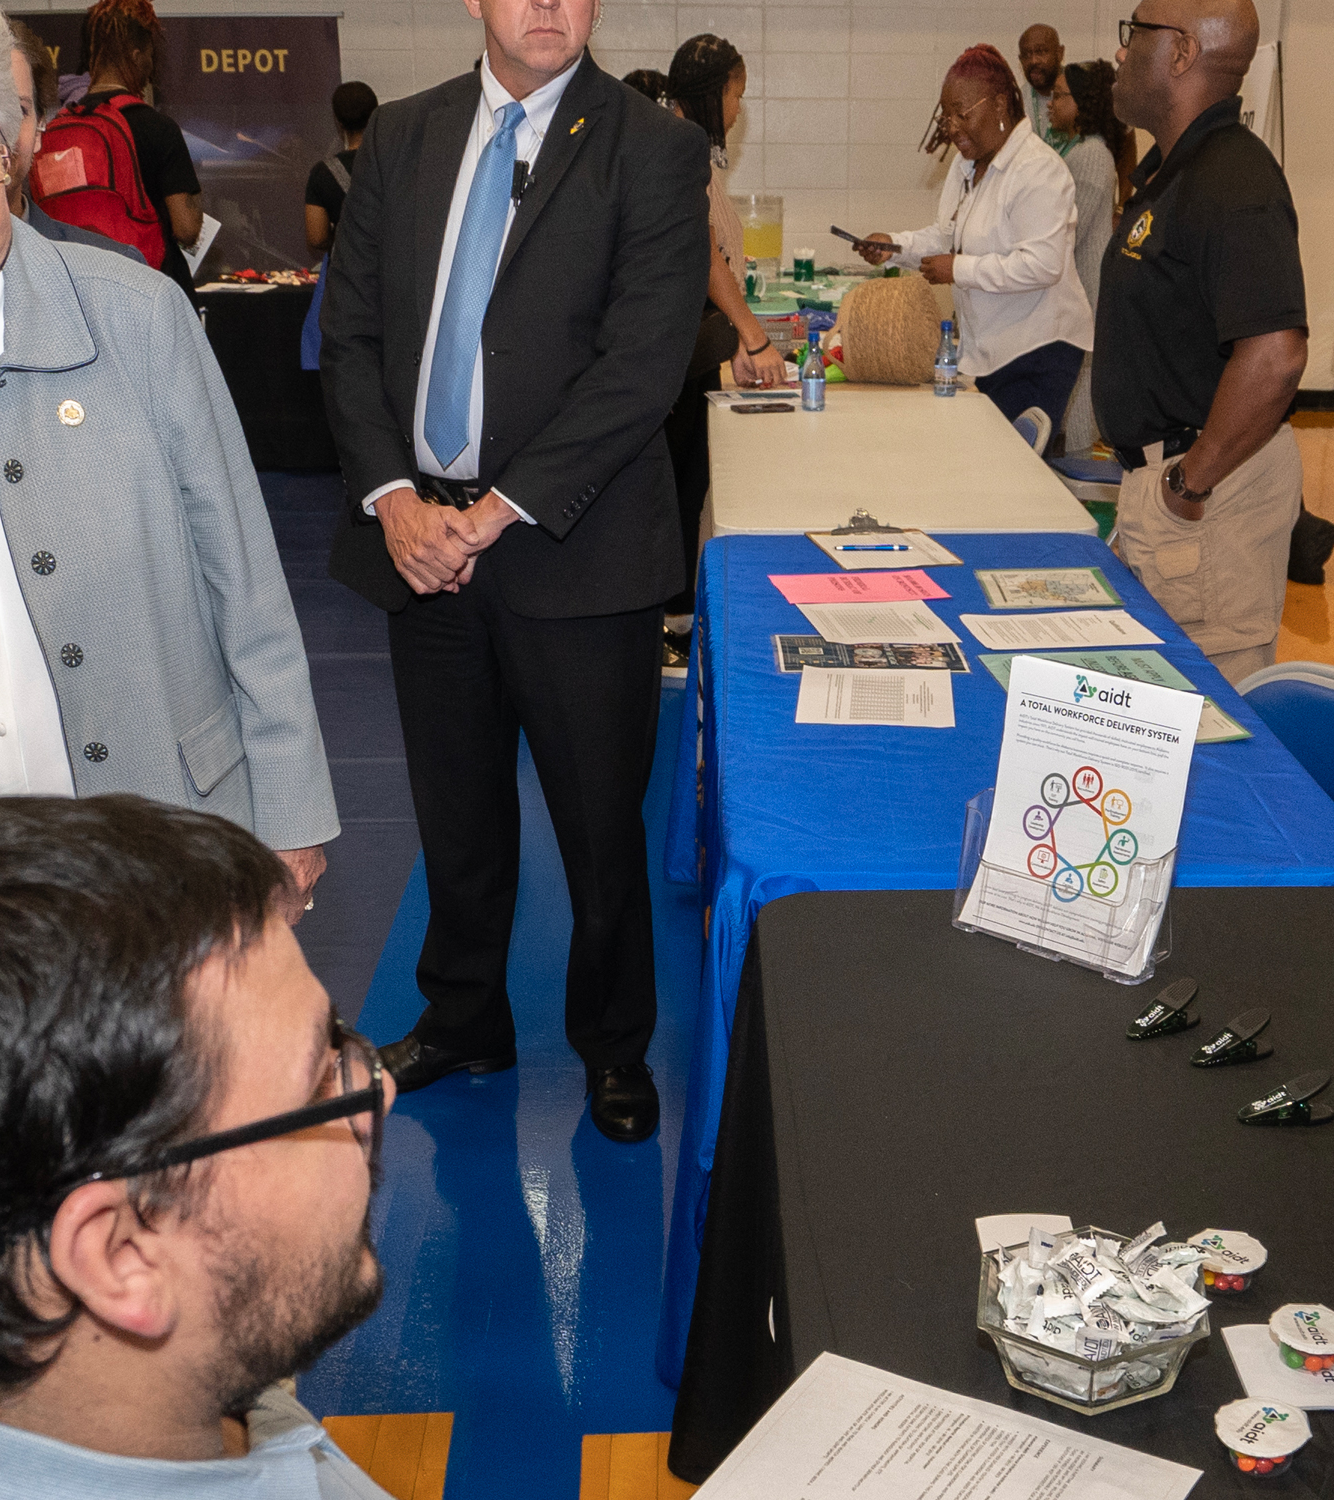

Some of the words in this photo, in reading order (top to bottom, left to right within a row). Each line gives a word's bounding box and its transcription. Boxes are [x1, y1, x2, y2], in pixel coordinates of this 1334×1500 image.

[200, 49, 289, 72] DEPOT
[1098, 688, 1132, 708] aidt
[1020, 699, 1027, 707] A
[1028, 700, 1053, 713] TOTAL
[1054, 705, 1105, 727] WORKFORCE
[1106, 719, 1147, 737] DELIVERY
[1147, 729, 1180, 744] SYSTEM
[1222, 1249, 1250, 1265] aidt
[1307, 1325, 1328, 1346] aidt
[1239, 1421, 1266, 1445] aidt
